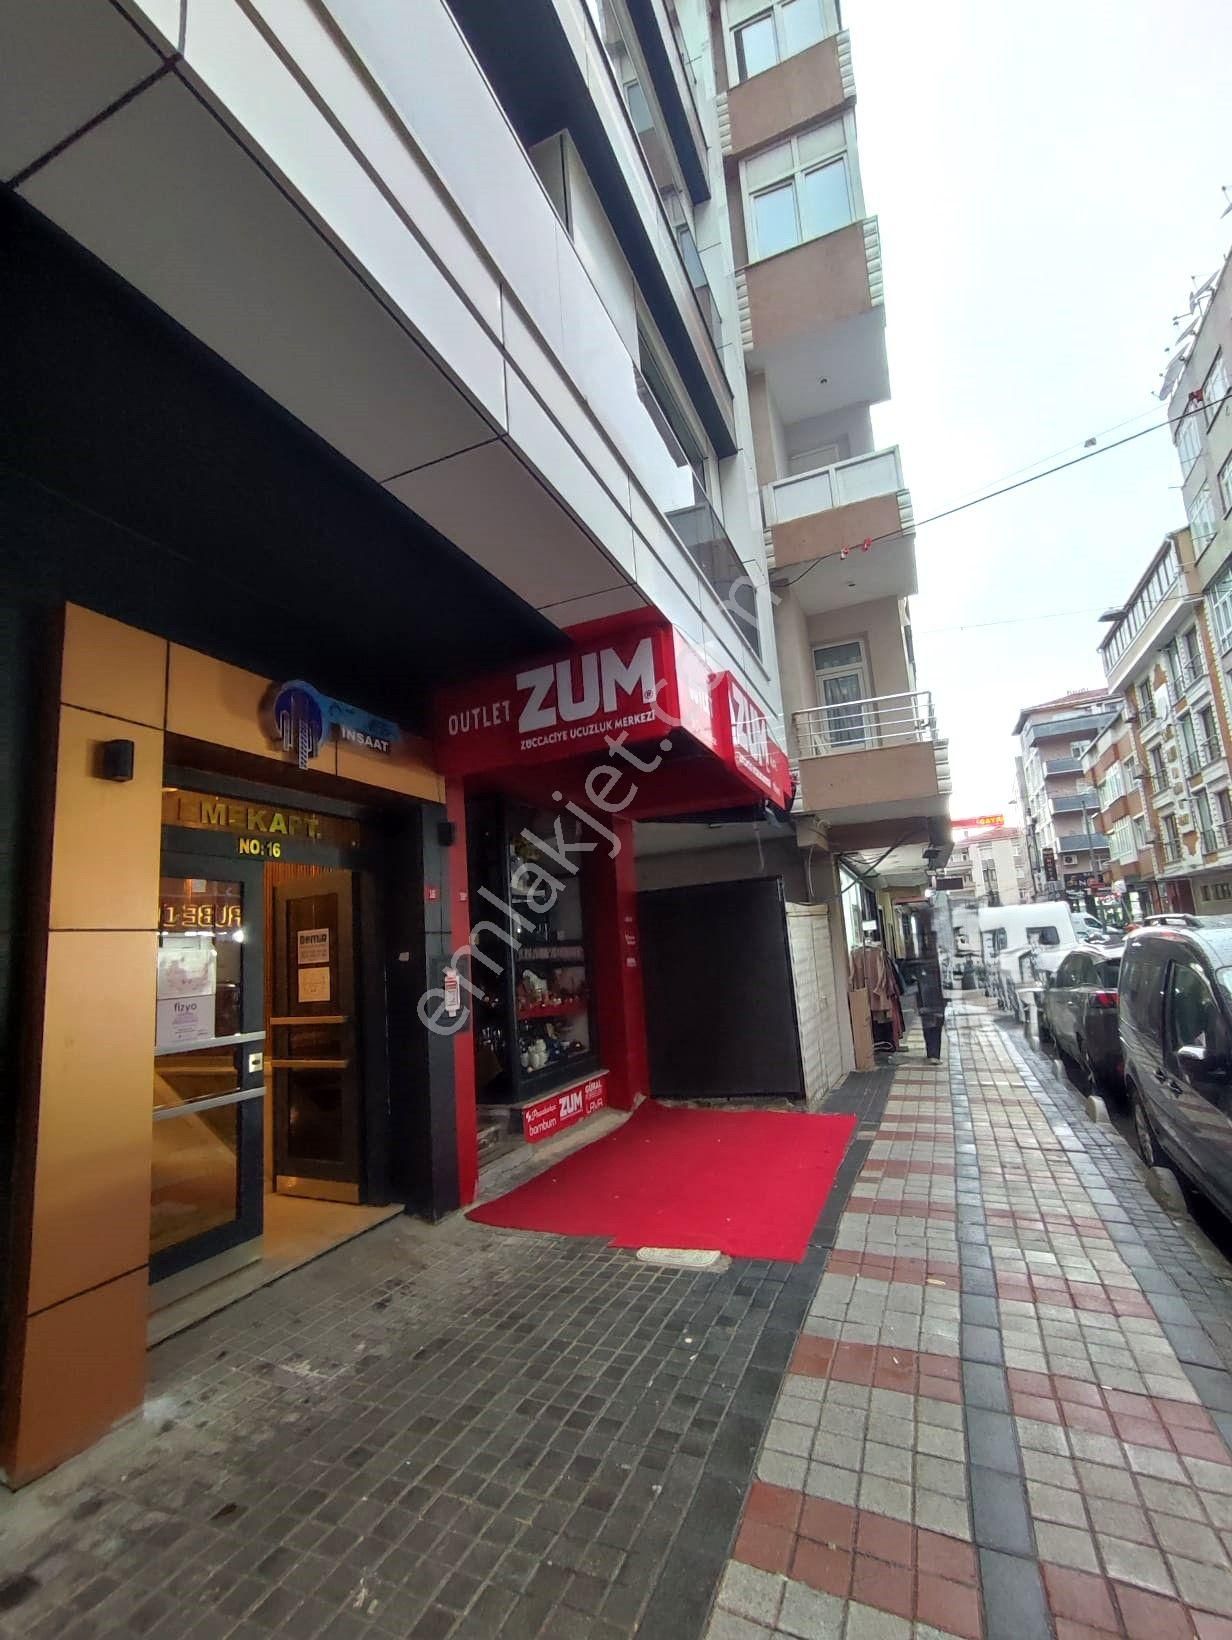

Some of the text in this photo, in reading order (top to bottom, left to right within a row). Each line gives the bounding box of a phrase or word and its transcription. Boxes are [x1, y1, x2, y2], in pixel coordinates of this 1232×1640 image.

[515, 636, 657, 734] ZUM
[449, 700, 511, 736] OUTLET
[569, 719, 614, 739] UCUZLUK
[559, 1090, 583, 1118] ZUM
